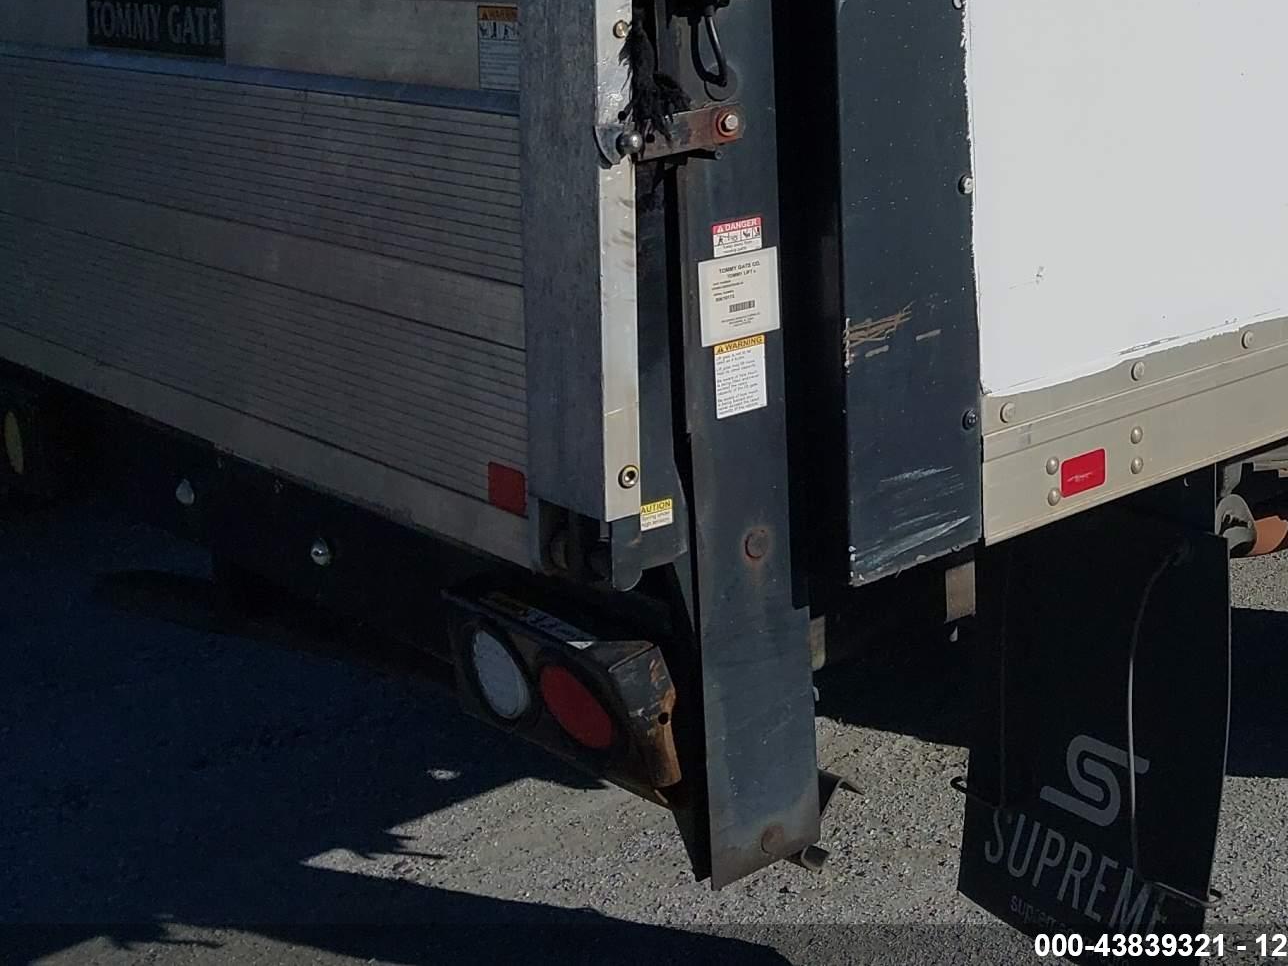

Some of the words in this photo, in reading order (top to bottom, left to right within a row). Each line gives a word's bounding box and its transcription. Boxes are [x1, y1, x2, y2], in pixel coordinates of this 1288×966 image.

[90, 0, 161, 42] TOMMY
[167, 4, 222, 46] GATE
[725, 218, 761, 231] DANGER
[725, 336, 763, 351] WARNING
[641, 500, 671, 514] AUTION
